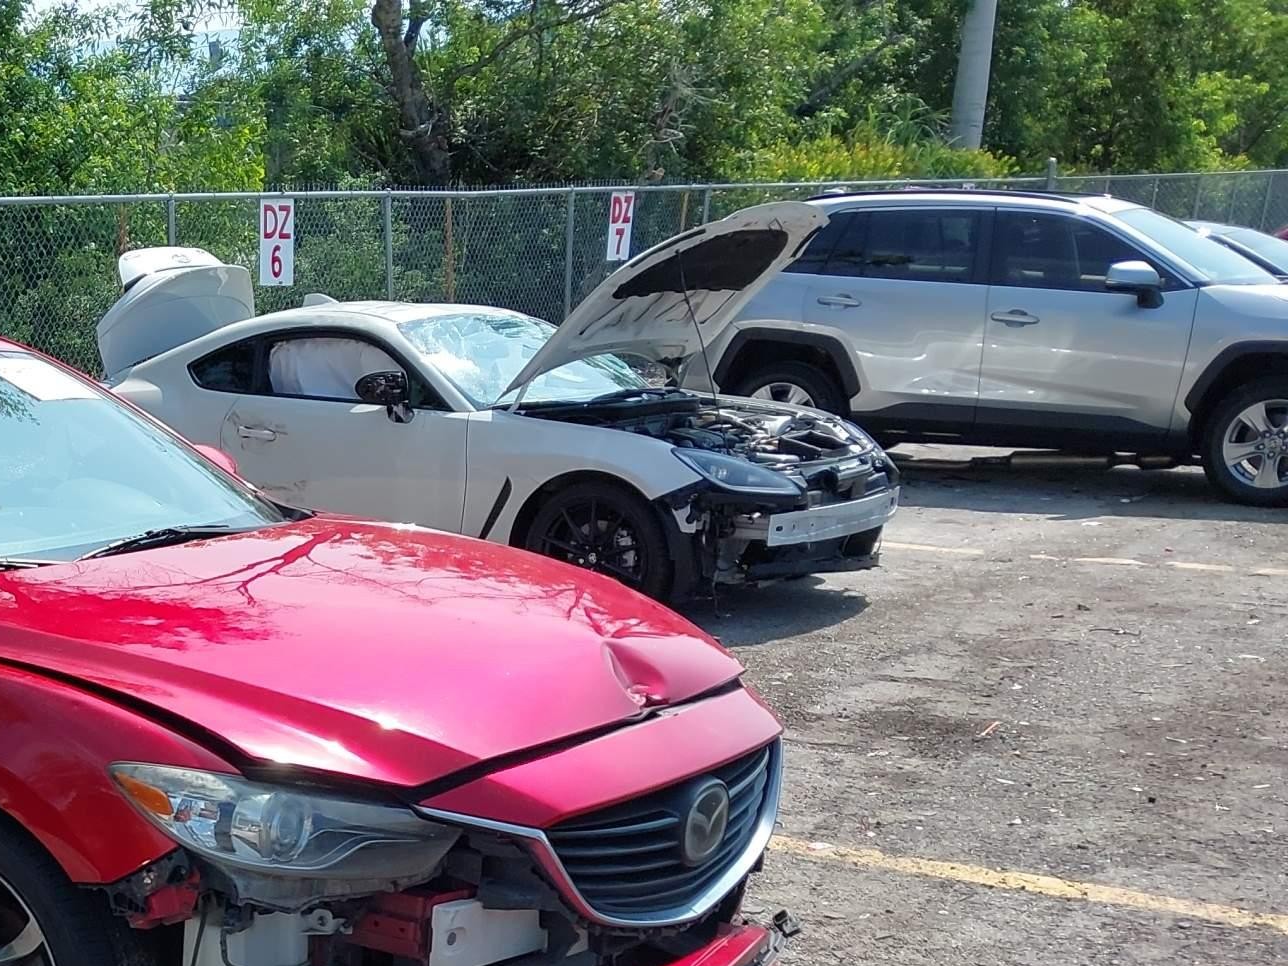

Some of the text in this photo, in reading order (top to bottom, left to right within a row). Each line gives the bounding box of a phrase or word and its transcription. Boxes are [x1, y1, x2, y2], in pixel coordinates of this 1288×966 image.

[263, 204, 291, 239] DZ
[611, 195, 633, 224] DZ
[615, 228, 625, 255] 7
[271, 244, 282, 278] 6
